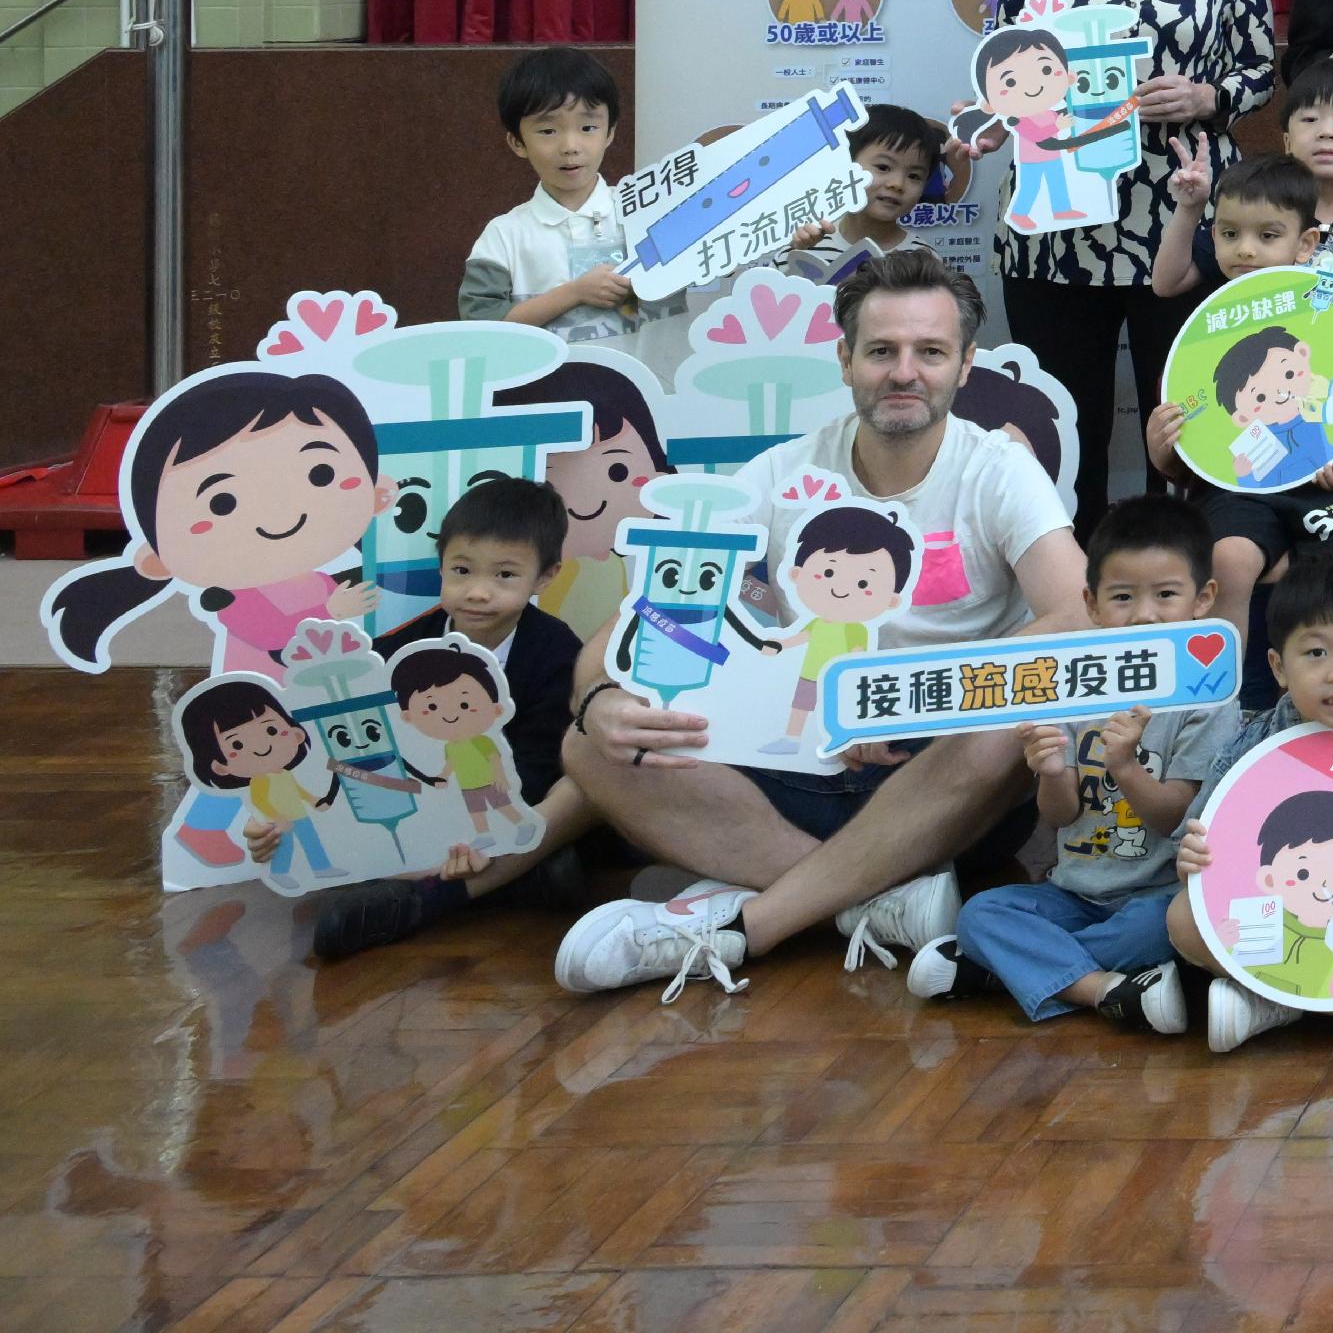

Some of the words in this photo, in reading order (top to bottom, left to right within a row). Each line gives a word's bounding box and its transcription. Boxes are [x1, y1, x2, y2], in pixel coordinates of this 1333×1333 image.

[766, 23, 885, 44] 50歲或以上
[619, 149, 700, 218] 記得
[696, 168, 866, 279] 打流感針
[1205, 289, 1296, 335] 減少缺課
[856, 648, 1160, 721] 接種流感疫苗
